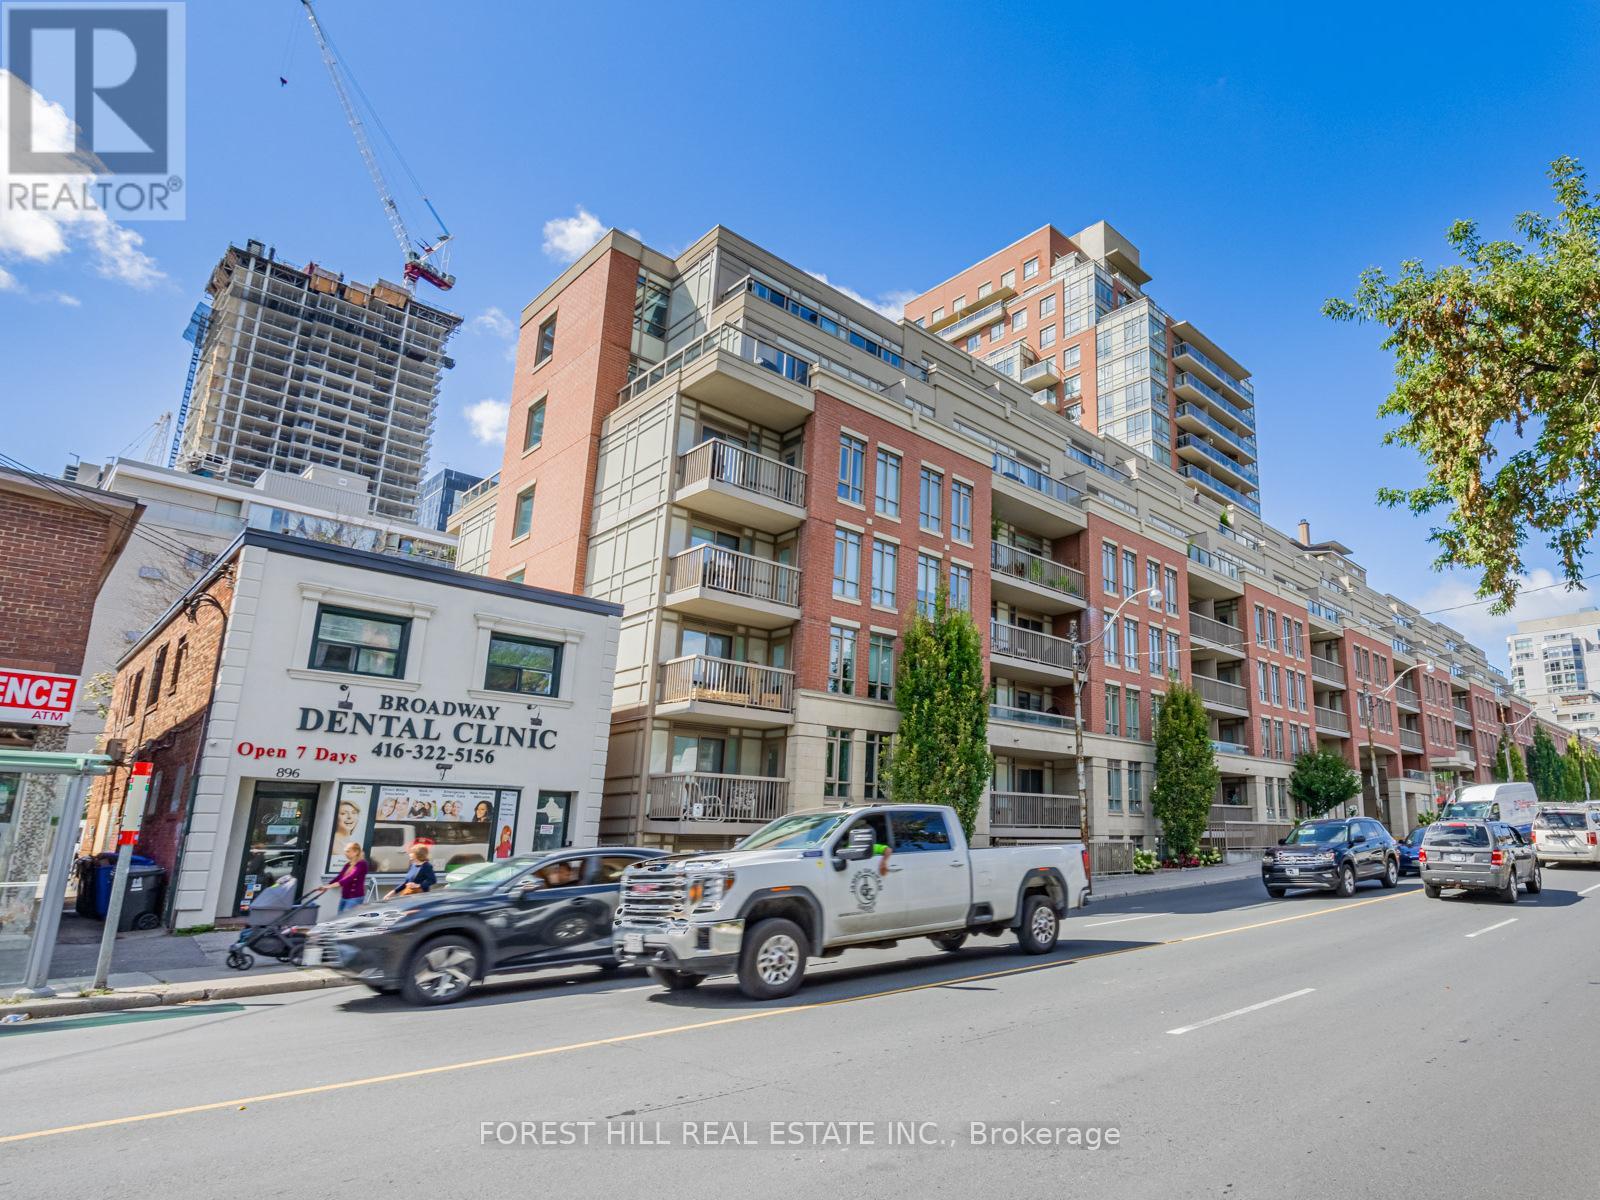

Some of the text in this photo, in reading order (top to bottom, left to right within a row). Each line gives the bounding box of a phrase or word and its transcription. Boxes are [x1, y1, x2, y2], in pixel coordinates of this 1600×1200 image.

[32, 710, 63, 721] ATM
[378, 694, 500, 720] BROADWAY
[296, 707, 558, 750] DENTAL CLINIC
[237, 741, 358, 764] Open 7 Days
[371, 742, 495, 764] 416-322-5156
[276, 767, 300, 778] 896
